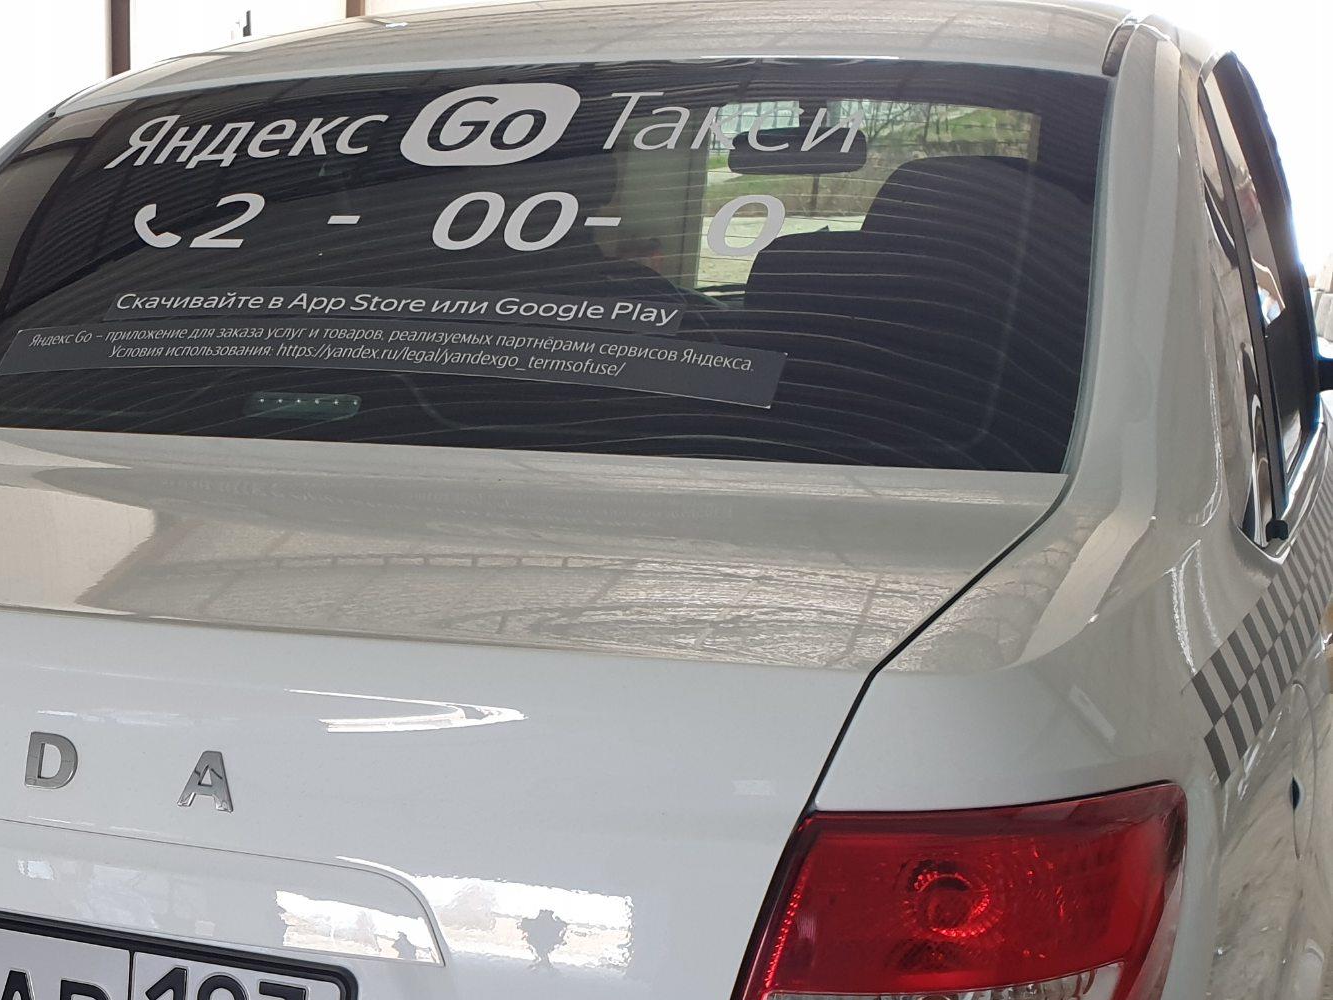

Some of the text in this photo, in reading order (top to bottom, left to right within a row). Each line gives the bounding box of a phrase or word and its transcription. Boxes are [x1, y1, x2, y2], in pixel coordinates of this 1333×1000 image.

[103, 90, 867, 170] Яндекс Go Такси
[190, 193, 265, 249] 2
[116, 292, 679, 327] Скачивайте в App Store или Google Play
[29, 333, 74, 347] Яндекс
[74, 330, 93, 343] Go
[104, 328, 188, 342] приложение
[187, 327, 216, 340] для
[216, 327, 265, 339] заказа
[265, 327, 307, 341] услуг
[308, 328, 319, 338] и
[387, 329, 493, 345] реализуемых
[495, 334, 596, 352] партнёрами
[598, 342, 679, 362] сервисов
[108, 345, 163, 358] Условия
